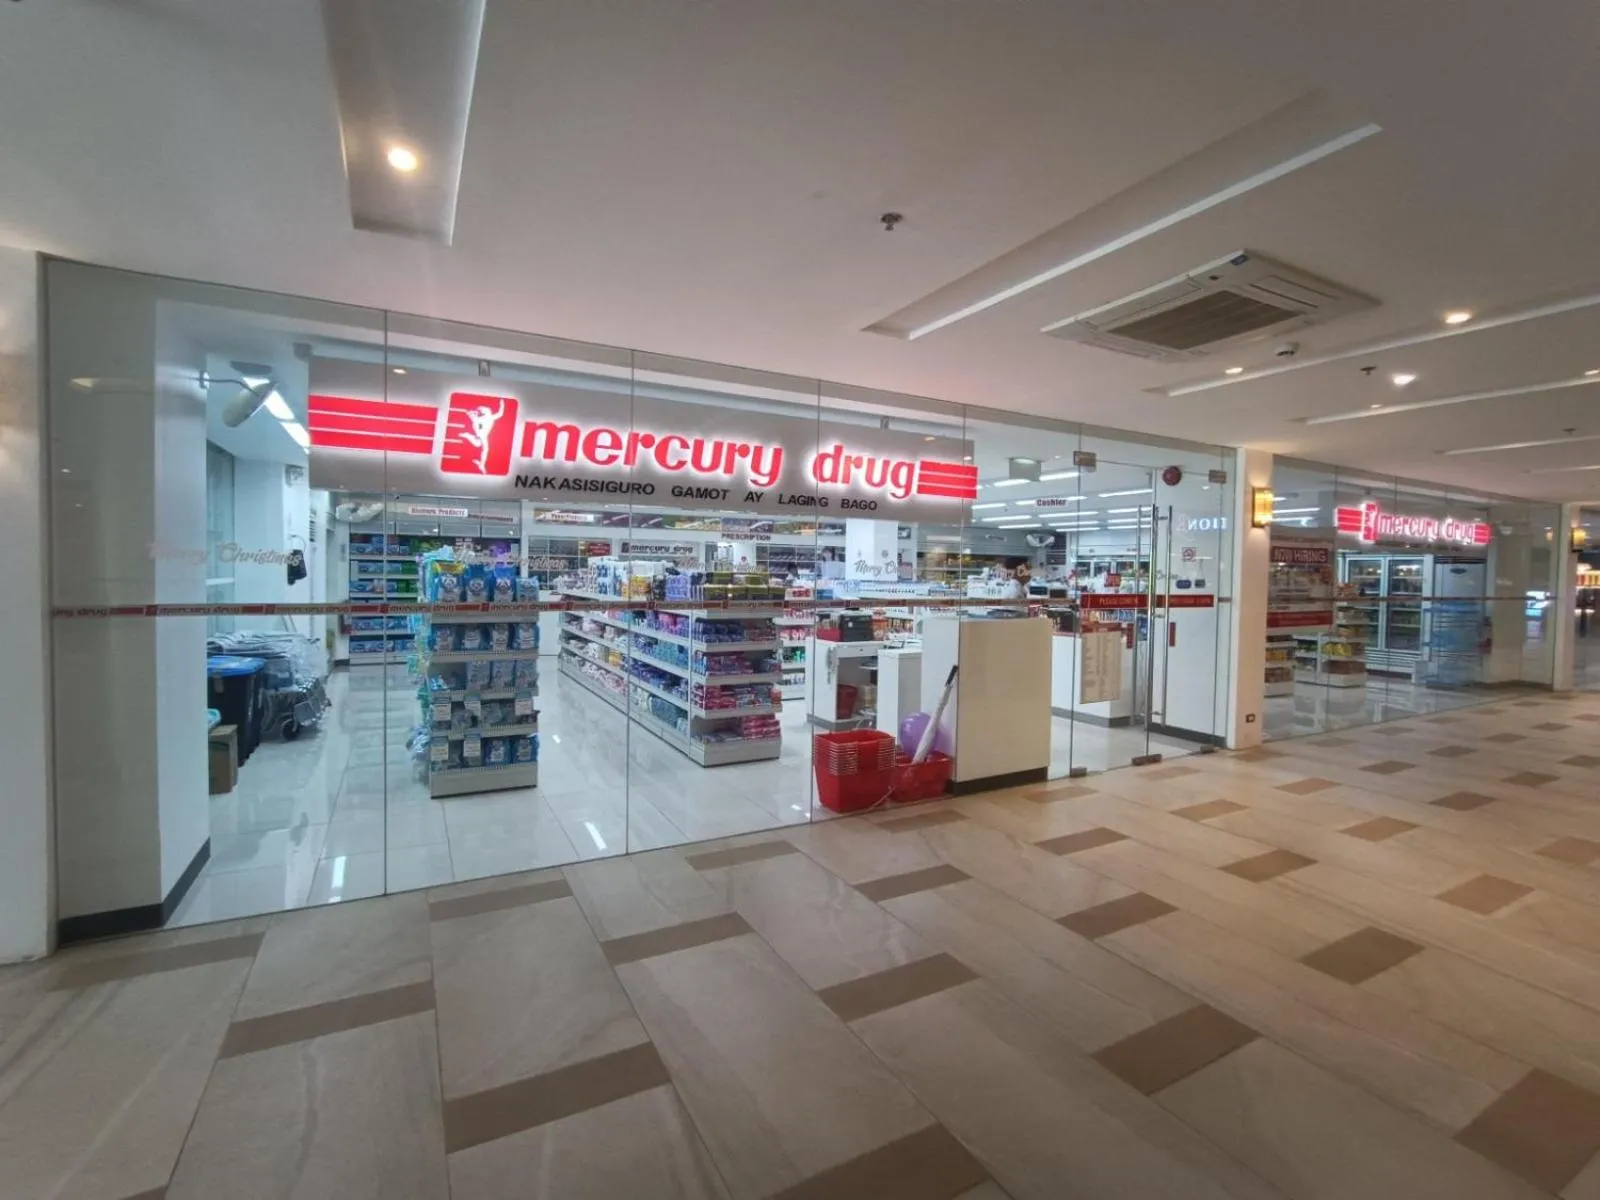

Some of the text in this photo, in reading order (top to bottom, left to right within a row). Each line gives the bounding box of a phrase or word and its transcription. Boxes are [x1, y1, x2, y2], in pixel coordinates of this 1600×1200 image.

[520, 420, 915, 499] mercury drug
[515, 475, 878, 511] NAKASISIGURO GAMOT AY LAGING BAGO
[1036, 499, 1067, 507] Cashier
[1380, 514, 1440, 543] mercury
[1445, 516, 1475, 546] drug
